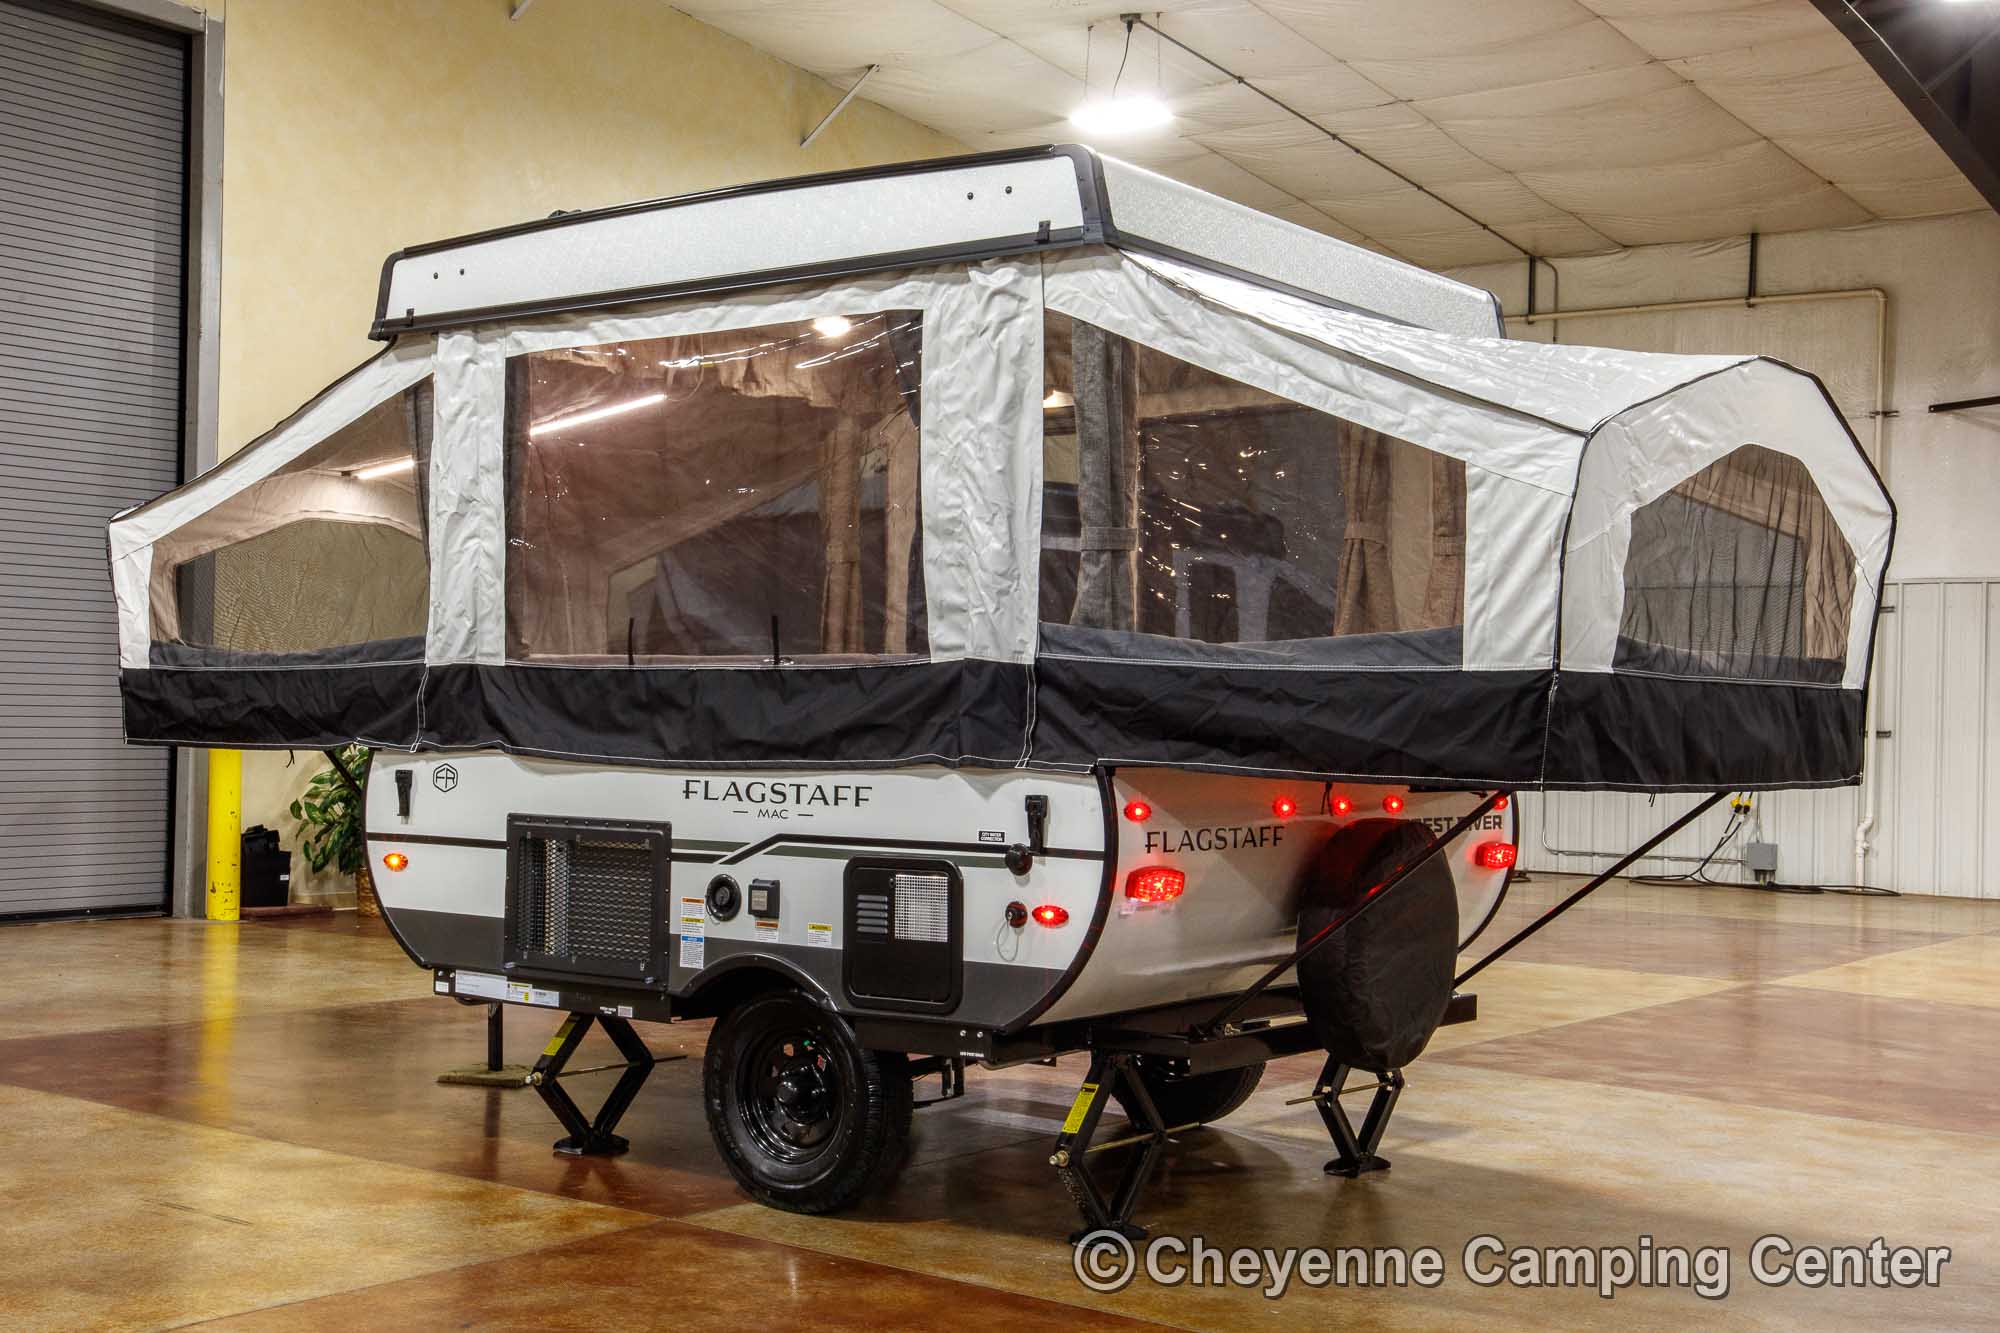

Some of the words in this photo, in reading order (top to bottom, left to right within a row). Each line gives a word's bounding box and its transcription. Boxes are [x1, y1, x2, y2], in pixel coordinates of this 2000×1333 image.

[683, 779, 873, 808] FLAGSTAFF
[757, 808, 790, 820] MAC
[1145, 825, 1285, 854] FLAGSTAFF
